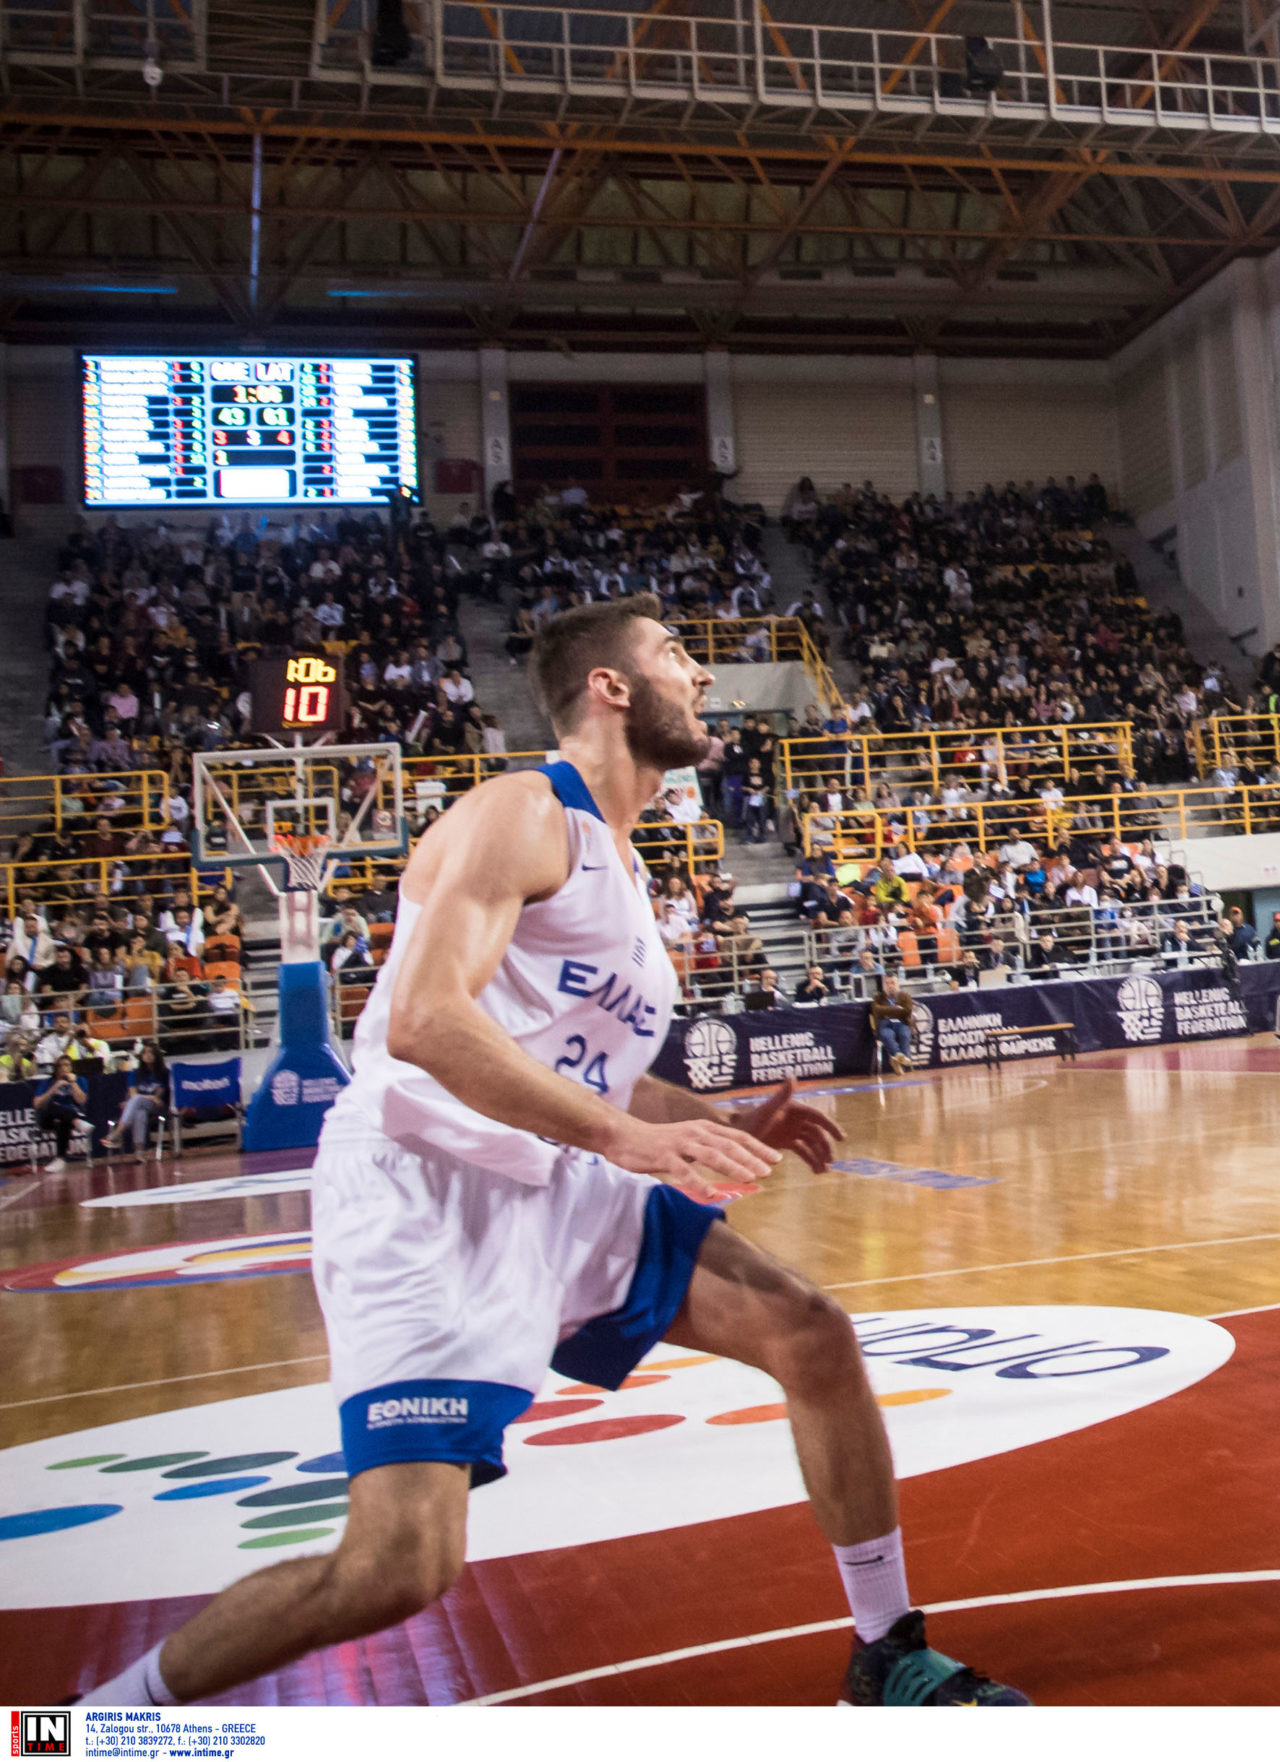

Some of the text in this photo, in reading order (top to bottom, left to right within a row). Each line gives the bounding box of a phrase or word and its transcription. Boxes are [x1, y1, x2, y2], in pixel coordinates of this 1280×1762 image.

[256, 362, 294, 381] LAT
[218, 408, 245, 425] 43
[263, 408, 289, 426] 61
[246, 430, 261, 446] 3
[215, 450, 229, 465] 1
[283, 686, 329, 722] 10
[1174, 987, 1231, 1006] HELLENIC
[1176, 1014, 1248, 1036] FEDERATION
[748, 1032, 815, 1052] HELLENIC
[554, 1033, 610, 1093] 24
[749, 1045, 837, 1069] BASKETBALL
[751, 1060, 834, 1084] FEDERATION
